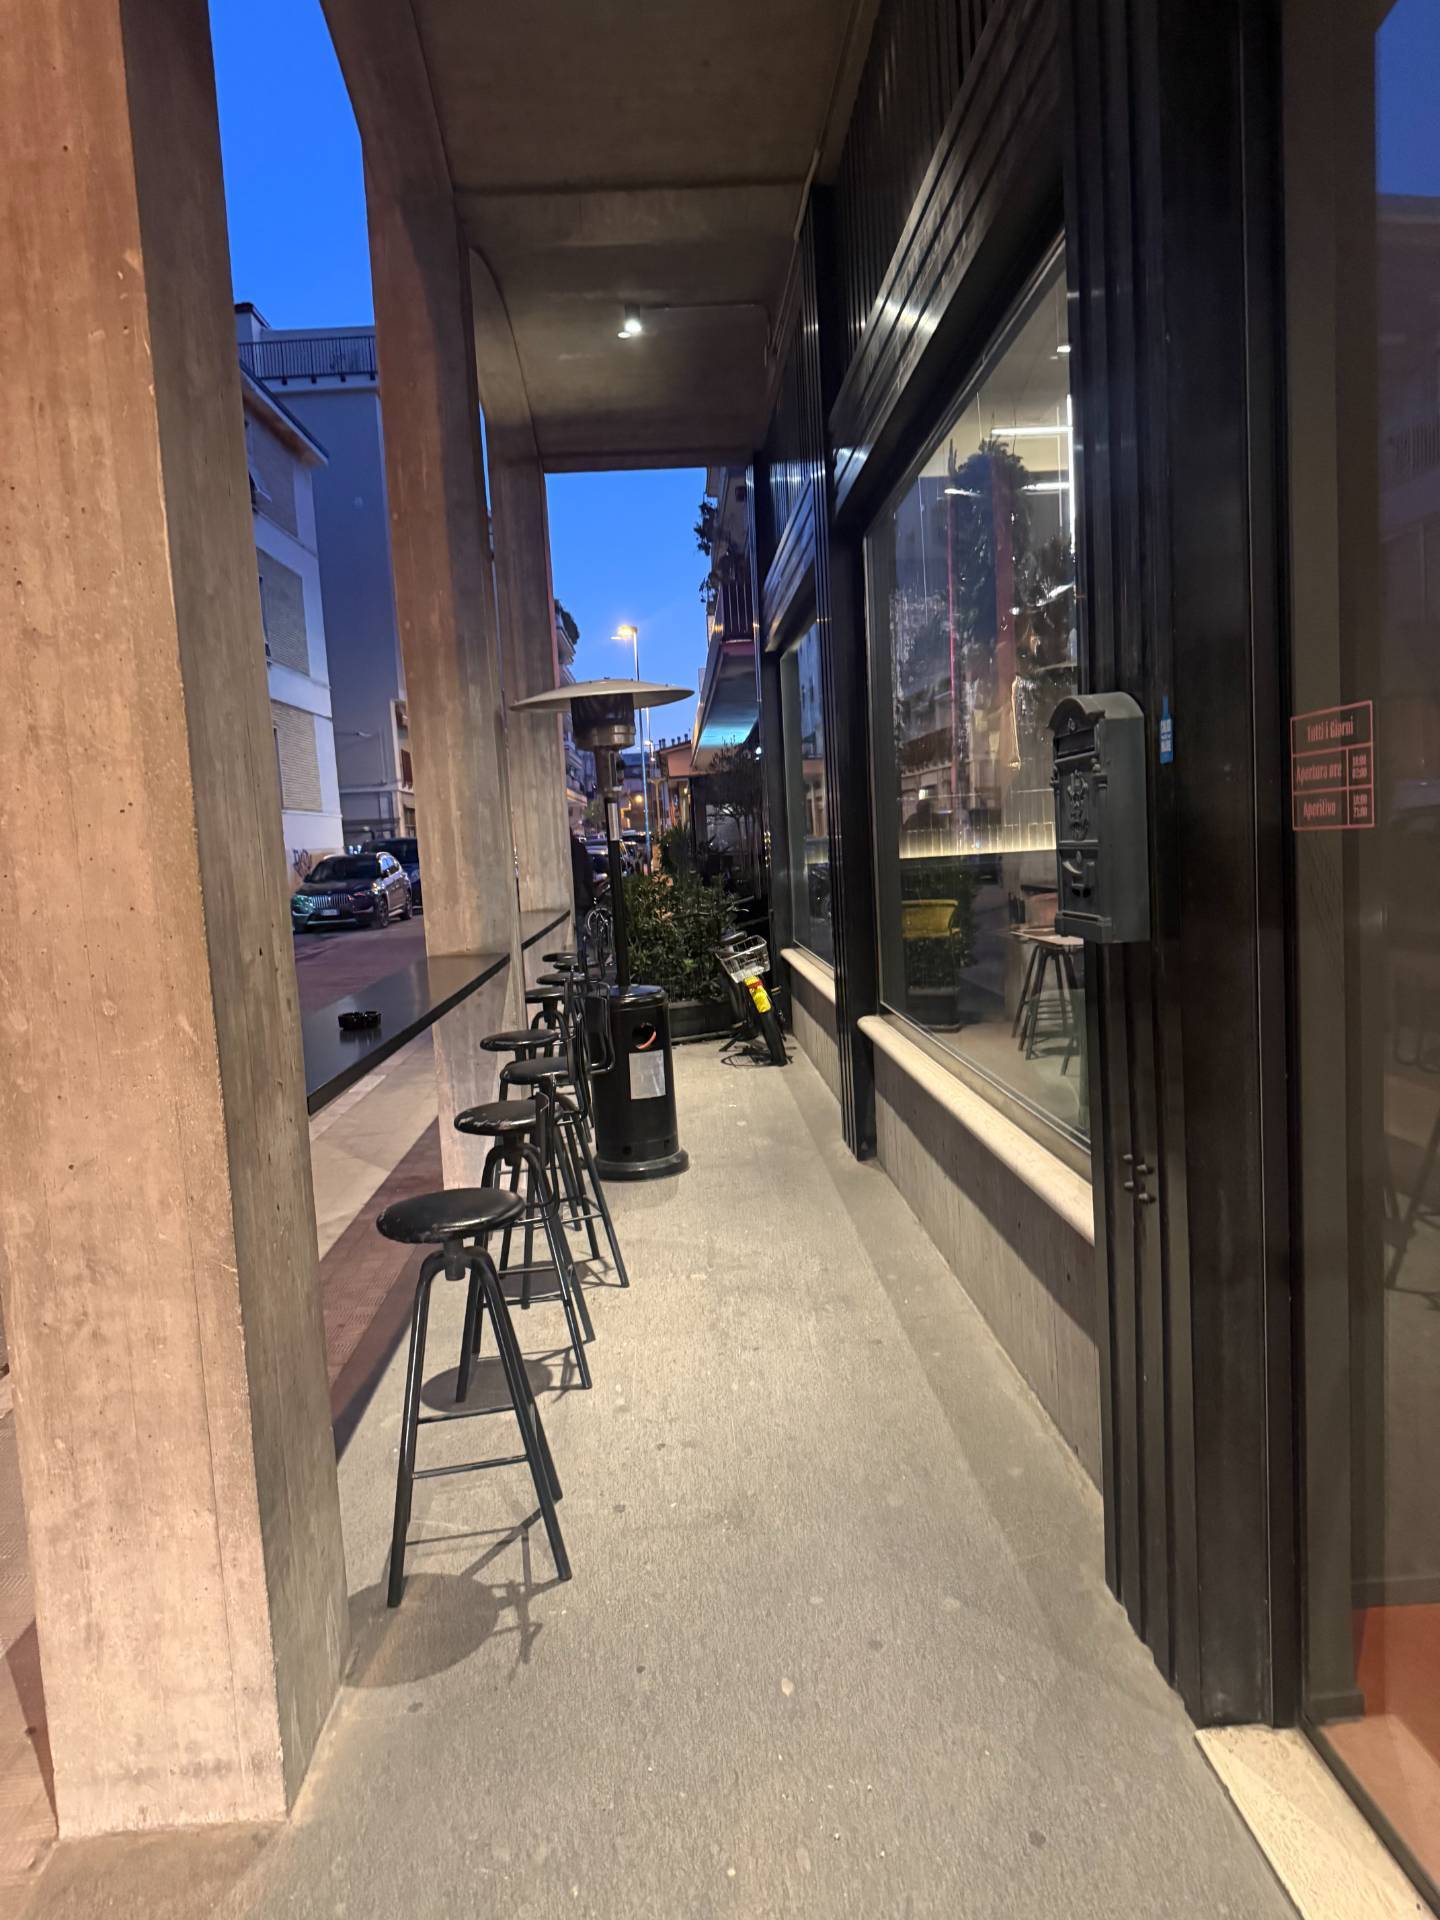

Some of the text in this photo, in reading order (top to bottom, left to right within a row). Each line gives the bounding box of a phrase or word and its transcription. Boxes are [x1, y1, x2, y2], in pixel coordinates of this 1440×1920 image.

[1330, 715, 1354, 738] Giorni
[1296, 765, 1328, 785] Apertura
[1303, 799, 1336, 820] Aperitivo
